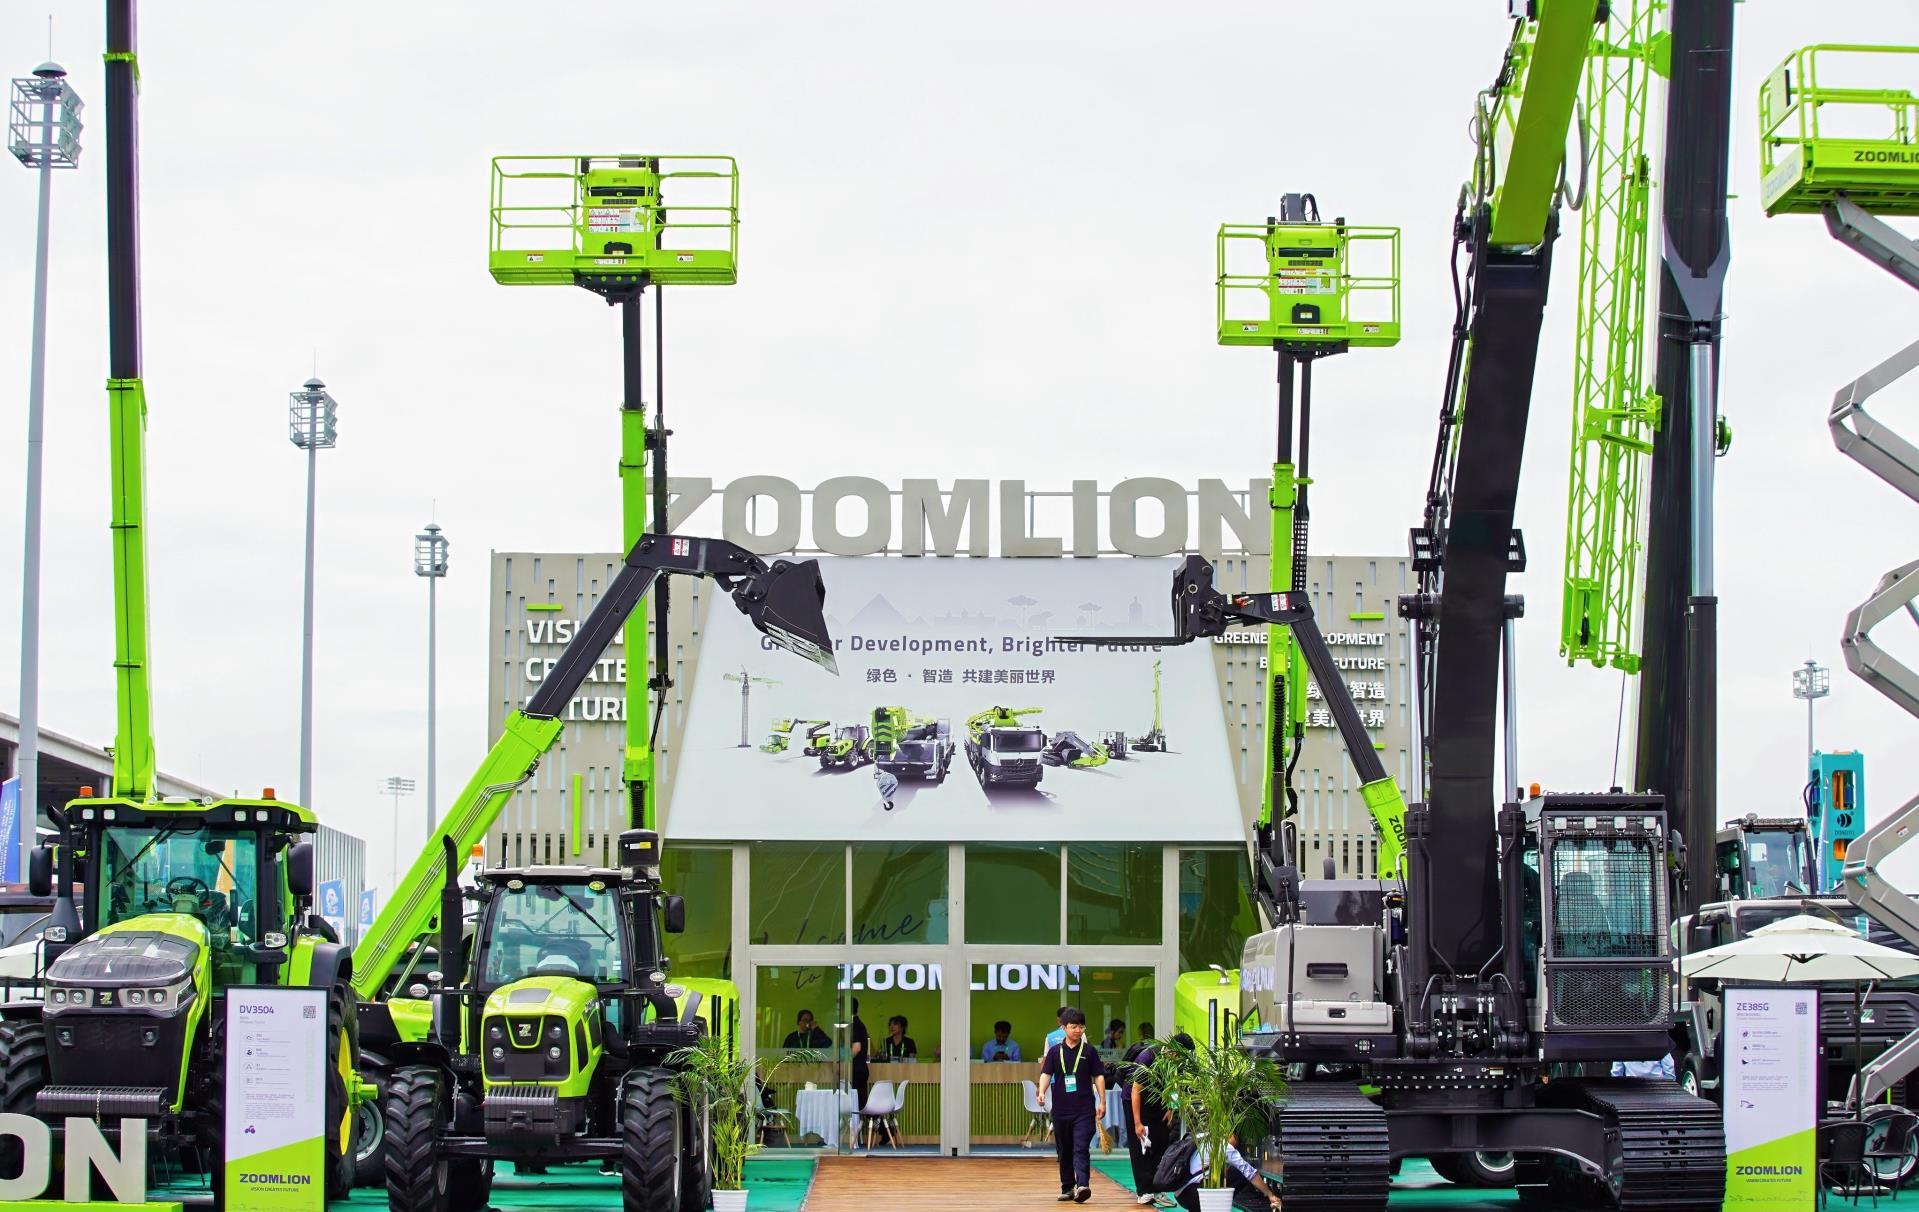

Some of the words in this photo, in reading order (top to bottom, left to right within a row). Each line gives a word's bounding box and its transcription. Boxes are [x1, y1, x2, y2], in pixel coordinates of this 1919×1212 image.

[644, 475, 1273, 558] ZOOMLION
[526, 619, 625, 644] VISI
[1215, 632, 1270, 644] GREENE
[851, 636, 993, 655] Development,
[866, 668, 897, 683] 绿色
[922, 668, 953, 683] 智造
[962, 668, 1056, 684] 共建美丽世界
[240, 1005, 274, 1014] DV3504
[1737, 1003, 1769, 1011] ZE385G
[1736, 1166, 1803, 1175] ZOOMLION
[240, 1174, 311, 1184] ZOOMLION
